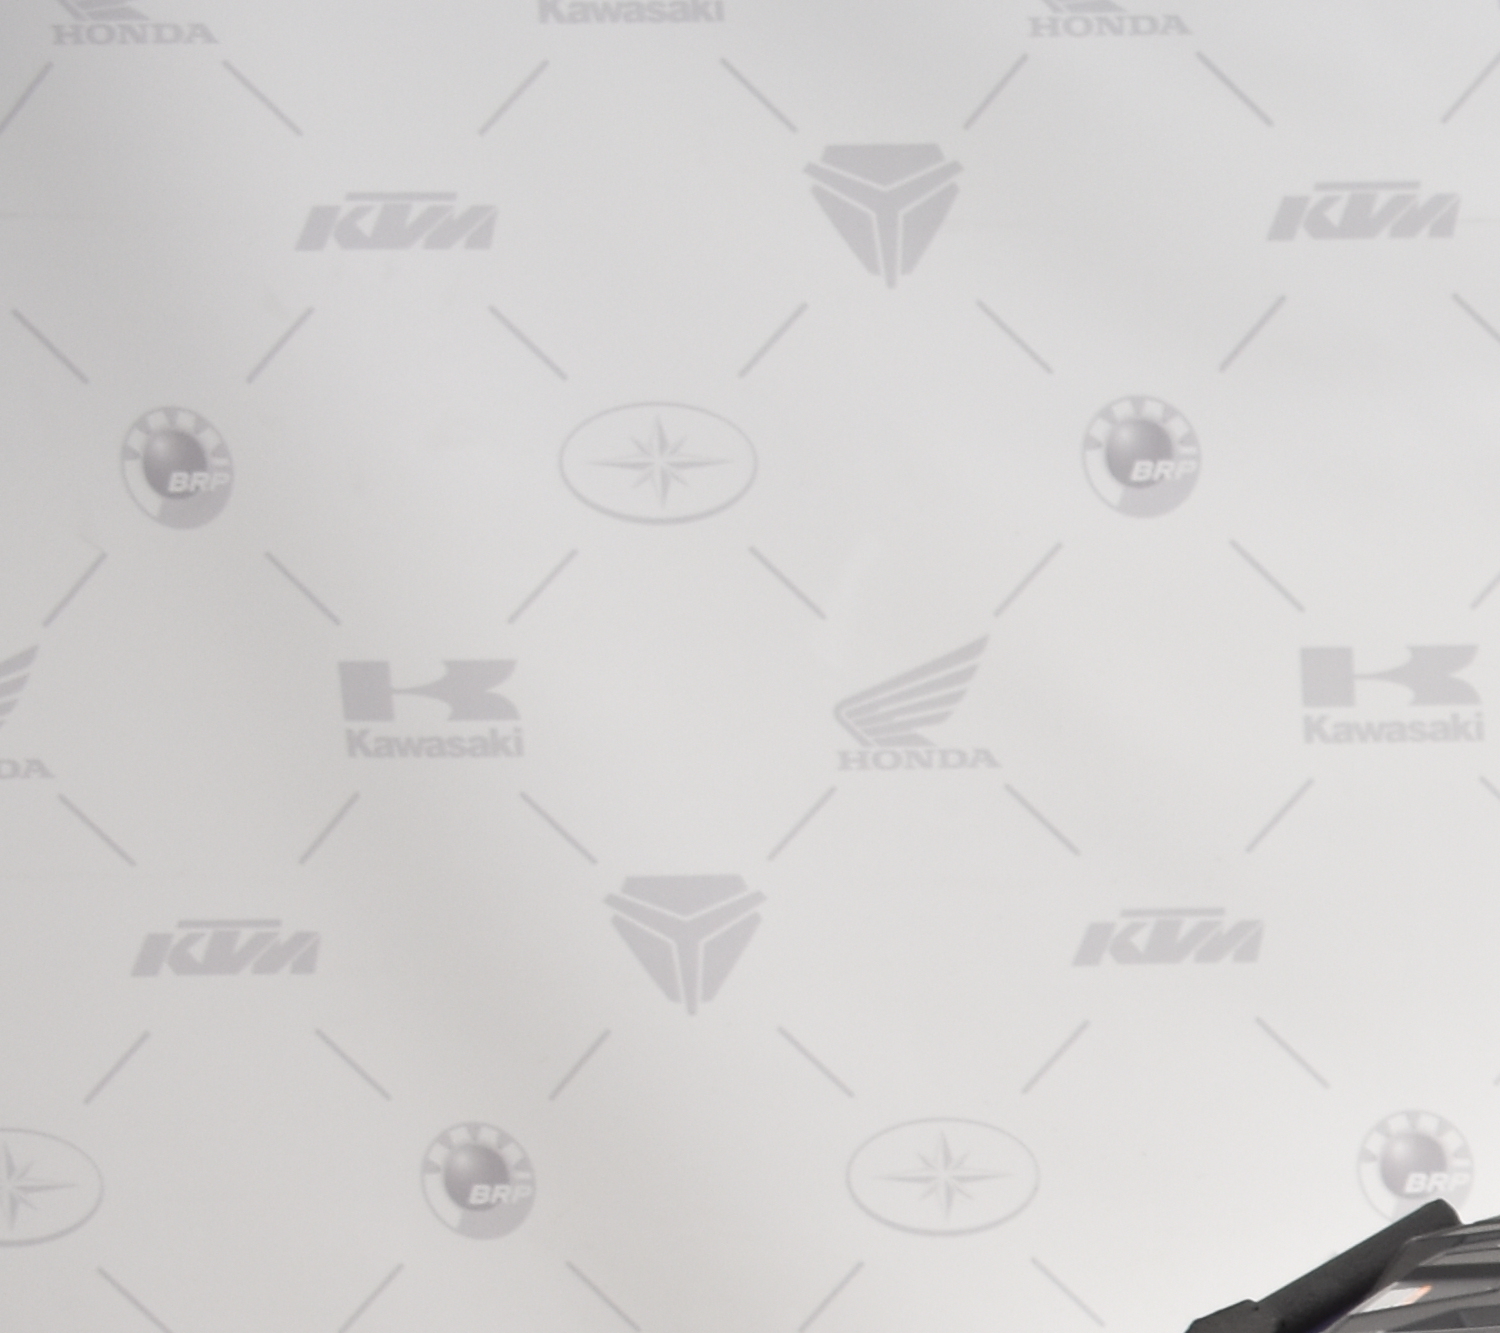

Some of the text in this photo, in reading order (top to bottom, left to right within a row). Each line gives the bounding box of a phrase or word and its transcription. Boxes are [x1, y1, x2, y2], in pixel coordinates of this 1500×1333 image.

[535, 0, 725, 25] Kawasaki
[1028, 10, 1193, 38] HONDA
[50, 22, 220, 46] HONDA
[295, 191, 497, 252] KTM
[1267, 180, 1459, 241] KTM
[168, 470, 232, 495] BRP
[1130, 460, 1197, 482] BRP
[1303, 712, 1485, 745] Kawasaki
[345, 727, 525, 760] Kawasaki
[838, 750, 1000, 770] HONDA
[131, 918, 320, 977] KTM
[1073, 906, 1264, 966] KTM
[467, 1182, 533, 1205] BRP
[1405, 1170, 1470, 1193] BRP
